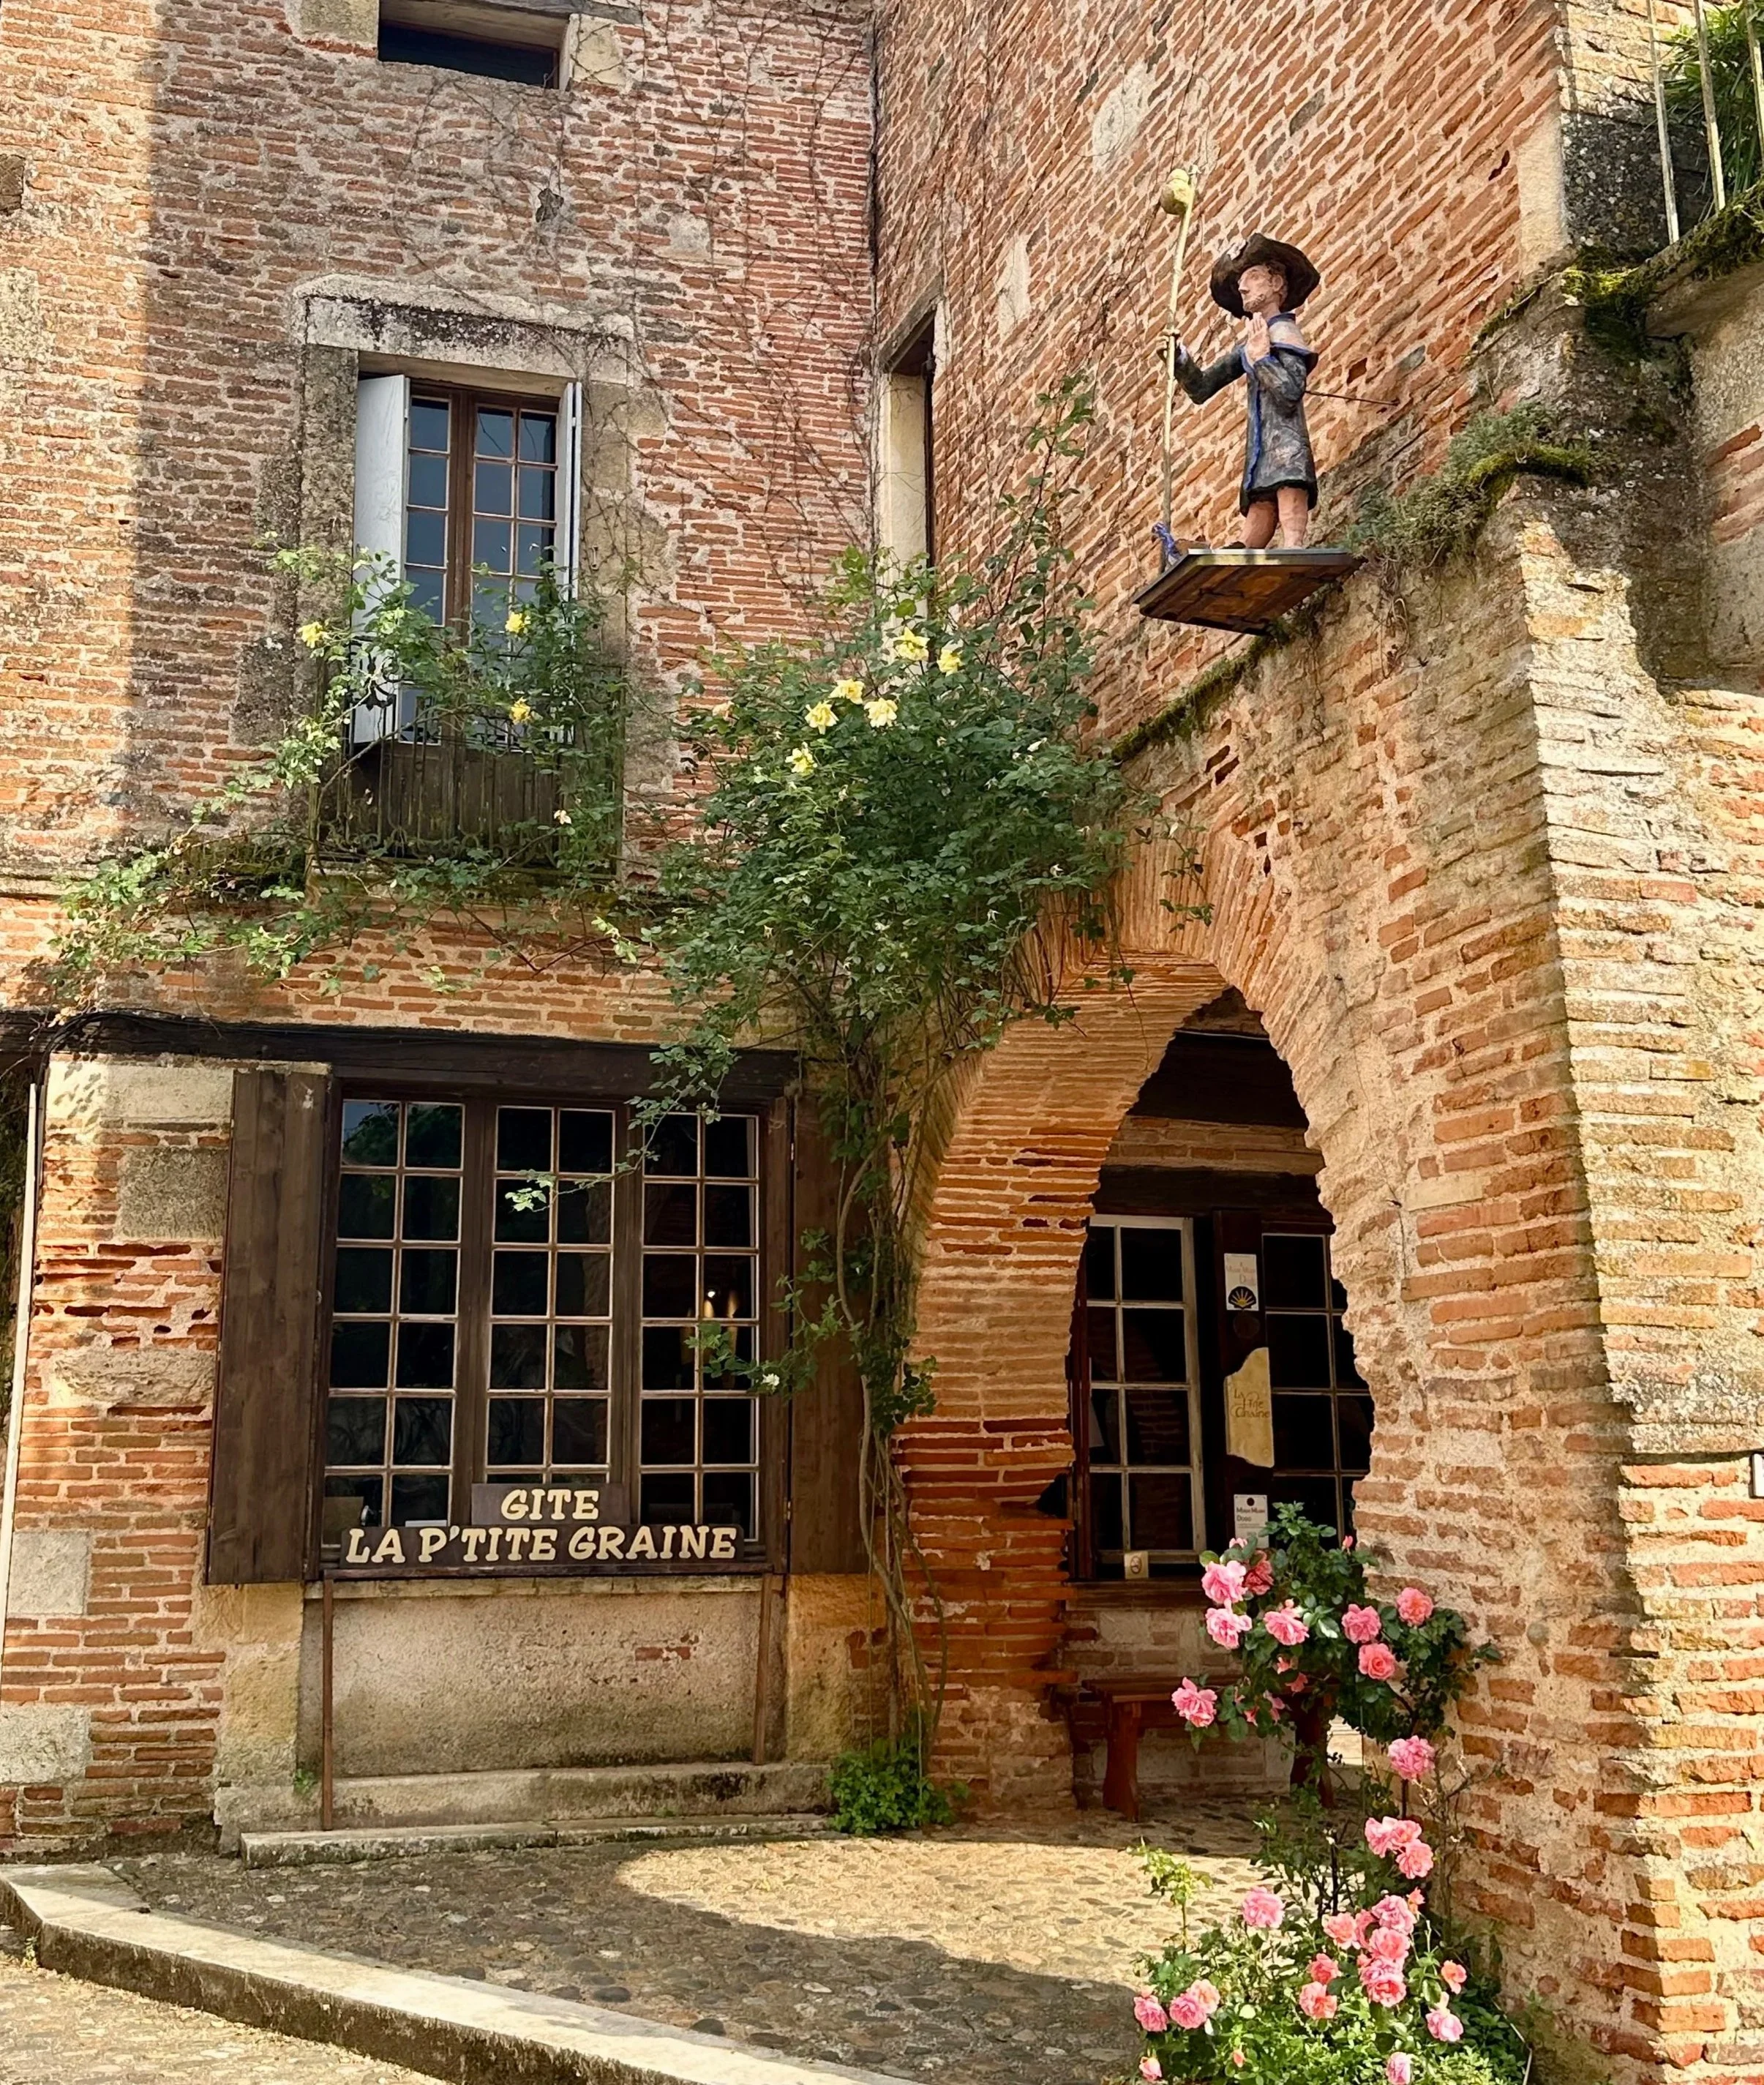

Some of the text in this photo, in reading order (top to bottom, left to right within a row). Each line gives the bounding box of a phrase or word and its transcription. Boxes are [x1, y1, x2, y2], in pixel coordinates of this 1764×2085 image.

[500, 1488, 599, 1520] GITE
[345, 1525, 737, 1563] LA P'TITE GRAINE
